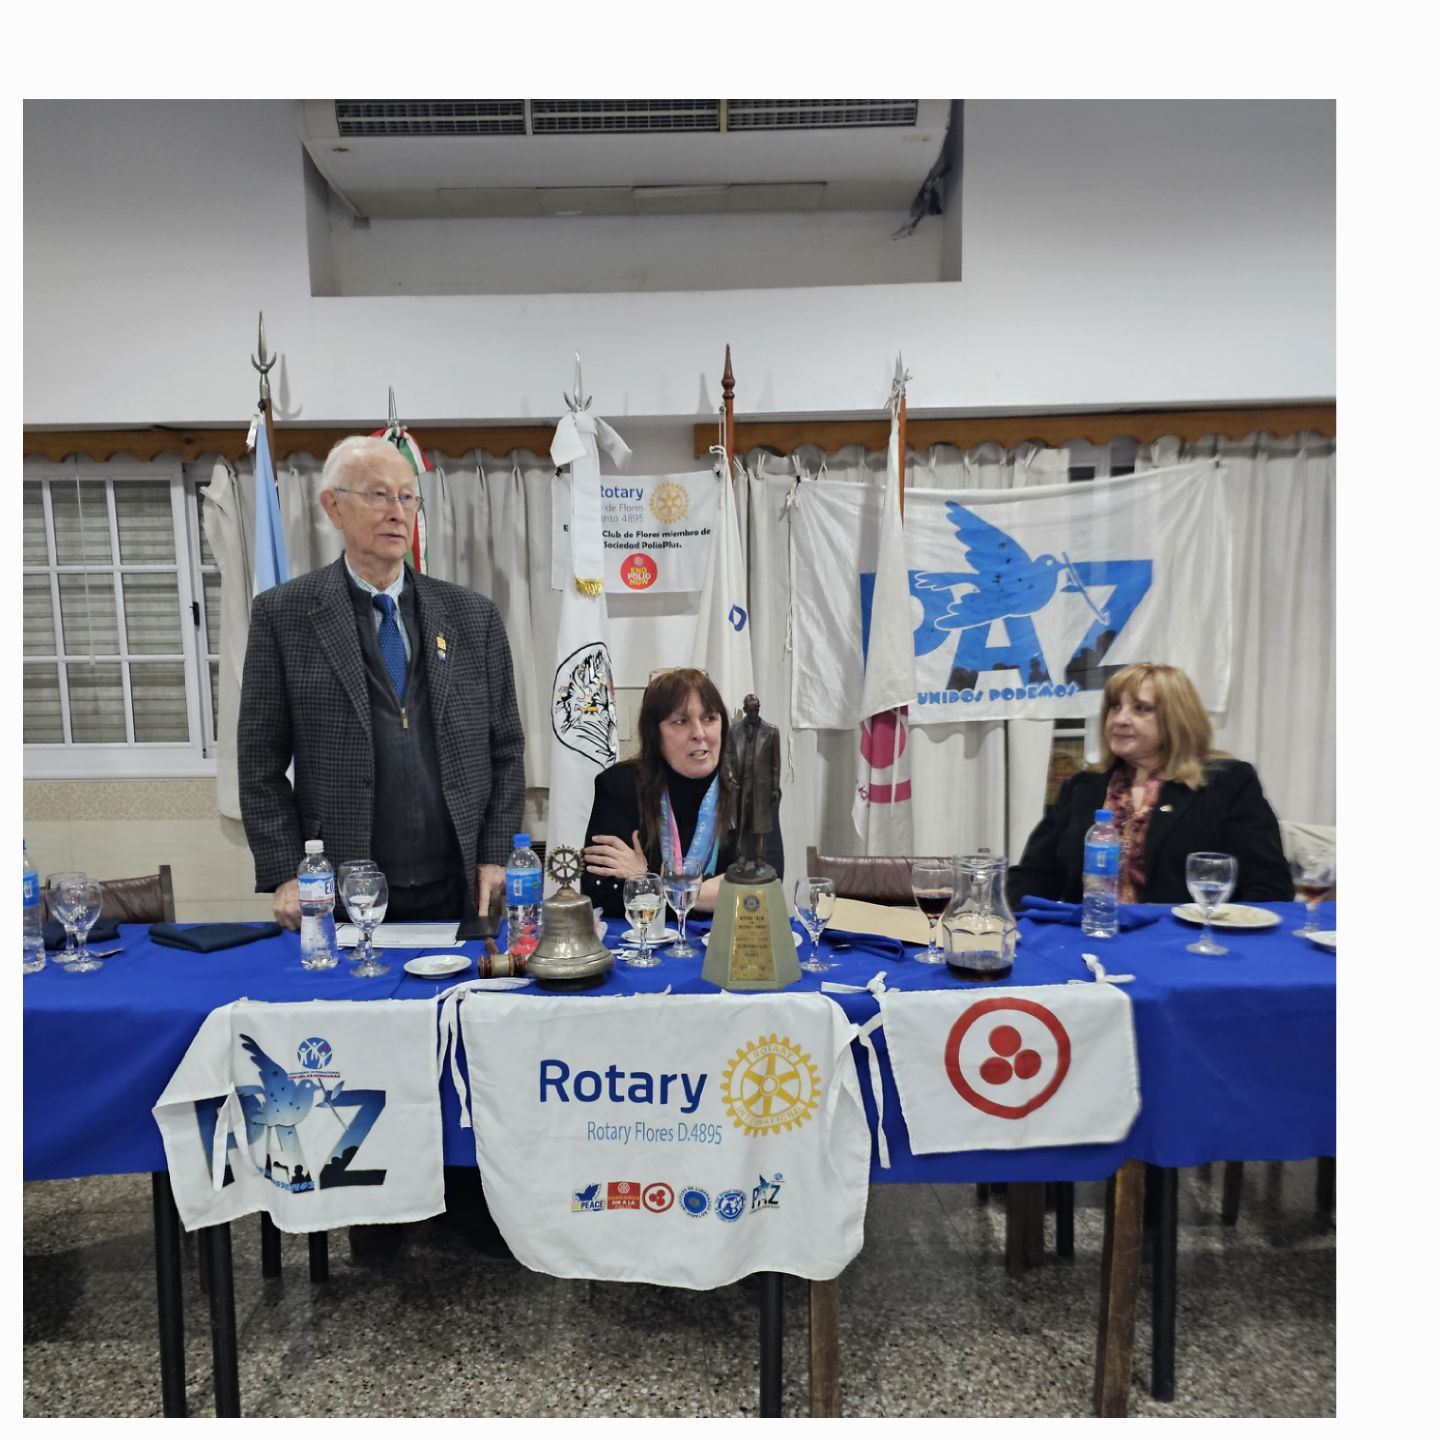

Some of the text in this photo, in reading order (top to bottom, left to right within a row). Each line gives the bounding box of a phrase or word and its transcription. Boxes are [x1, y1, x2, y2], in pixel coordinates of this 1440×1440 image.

[602, 530, 621, 538] Club
[636, 530, 660, 538] Flores
[662, 529, 698, 538] miembro
[701, 528, 711, 536] de
[603, 541, 682, 549] Sociedad PolioPlus.
[917, 681, 1080, 705] UNIDOS PODEMOS
[539, 1058, 708, 1114] Rotary
[587, 1121, 722, 1145] Rotary Flores D.4895
[580, 1200, 604, 1209] PEACE
[751, 1184, 780, 1209] PAZ
